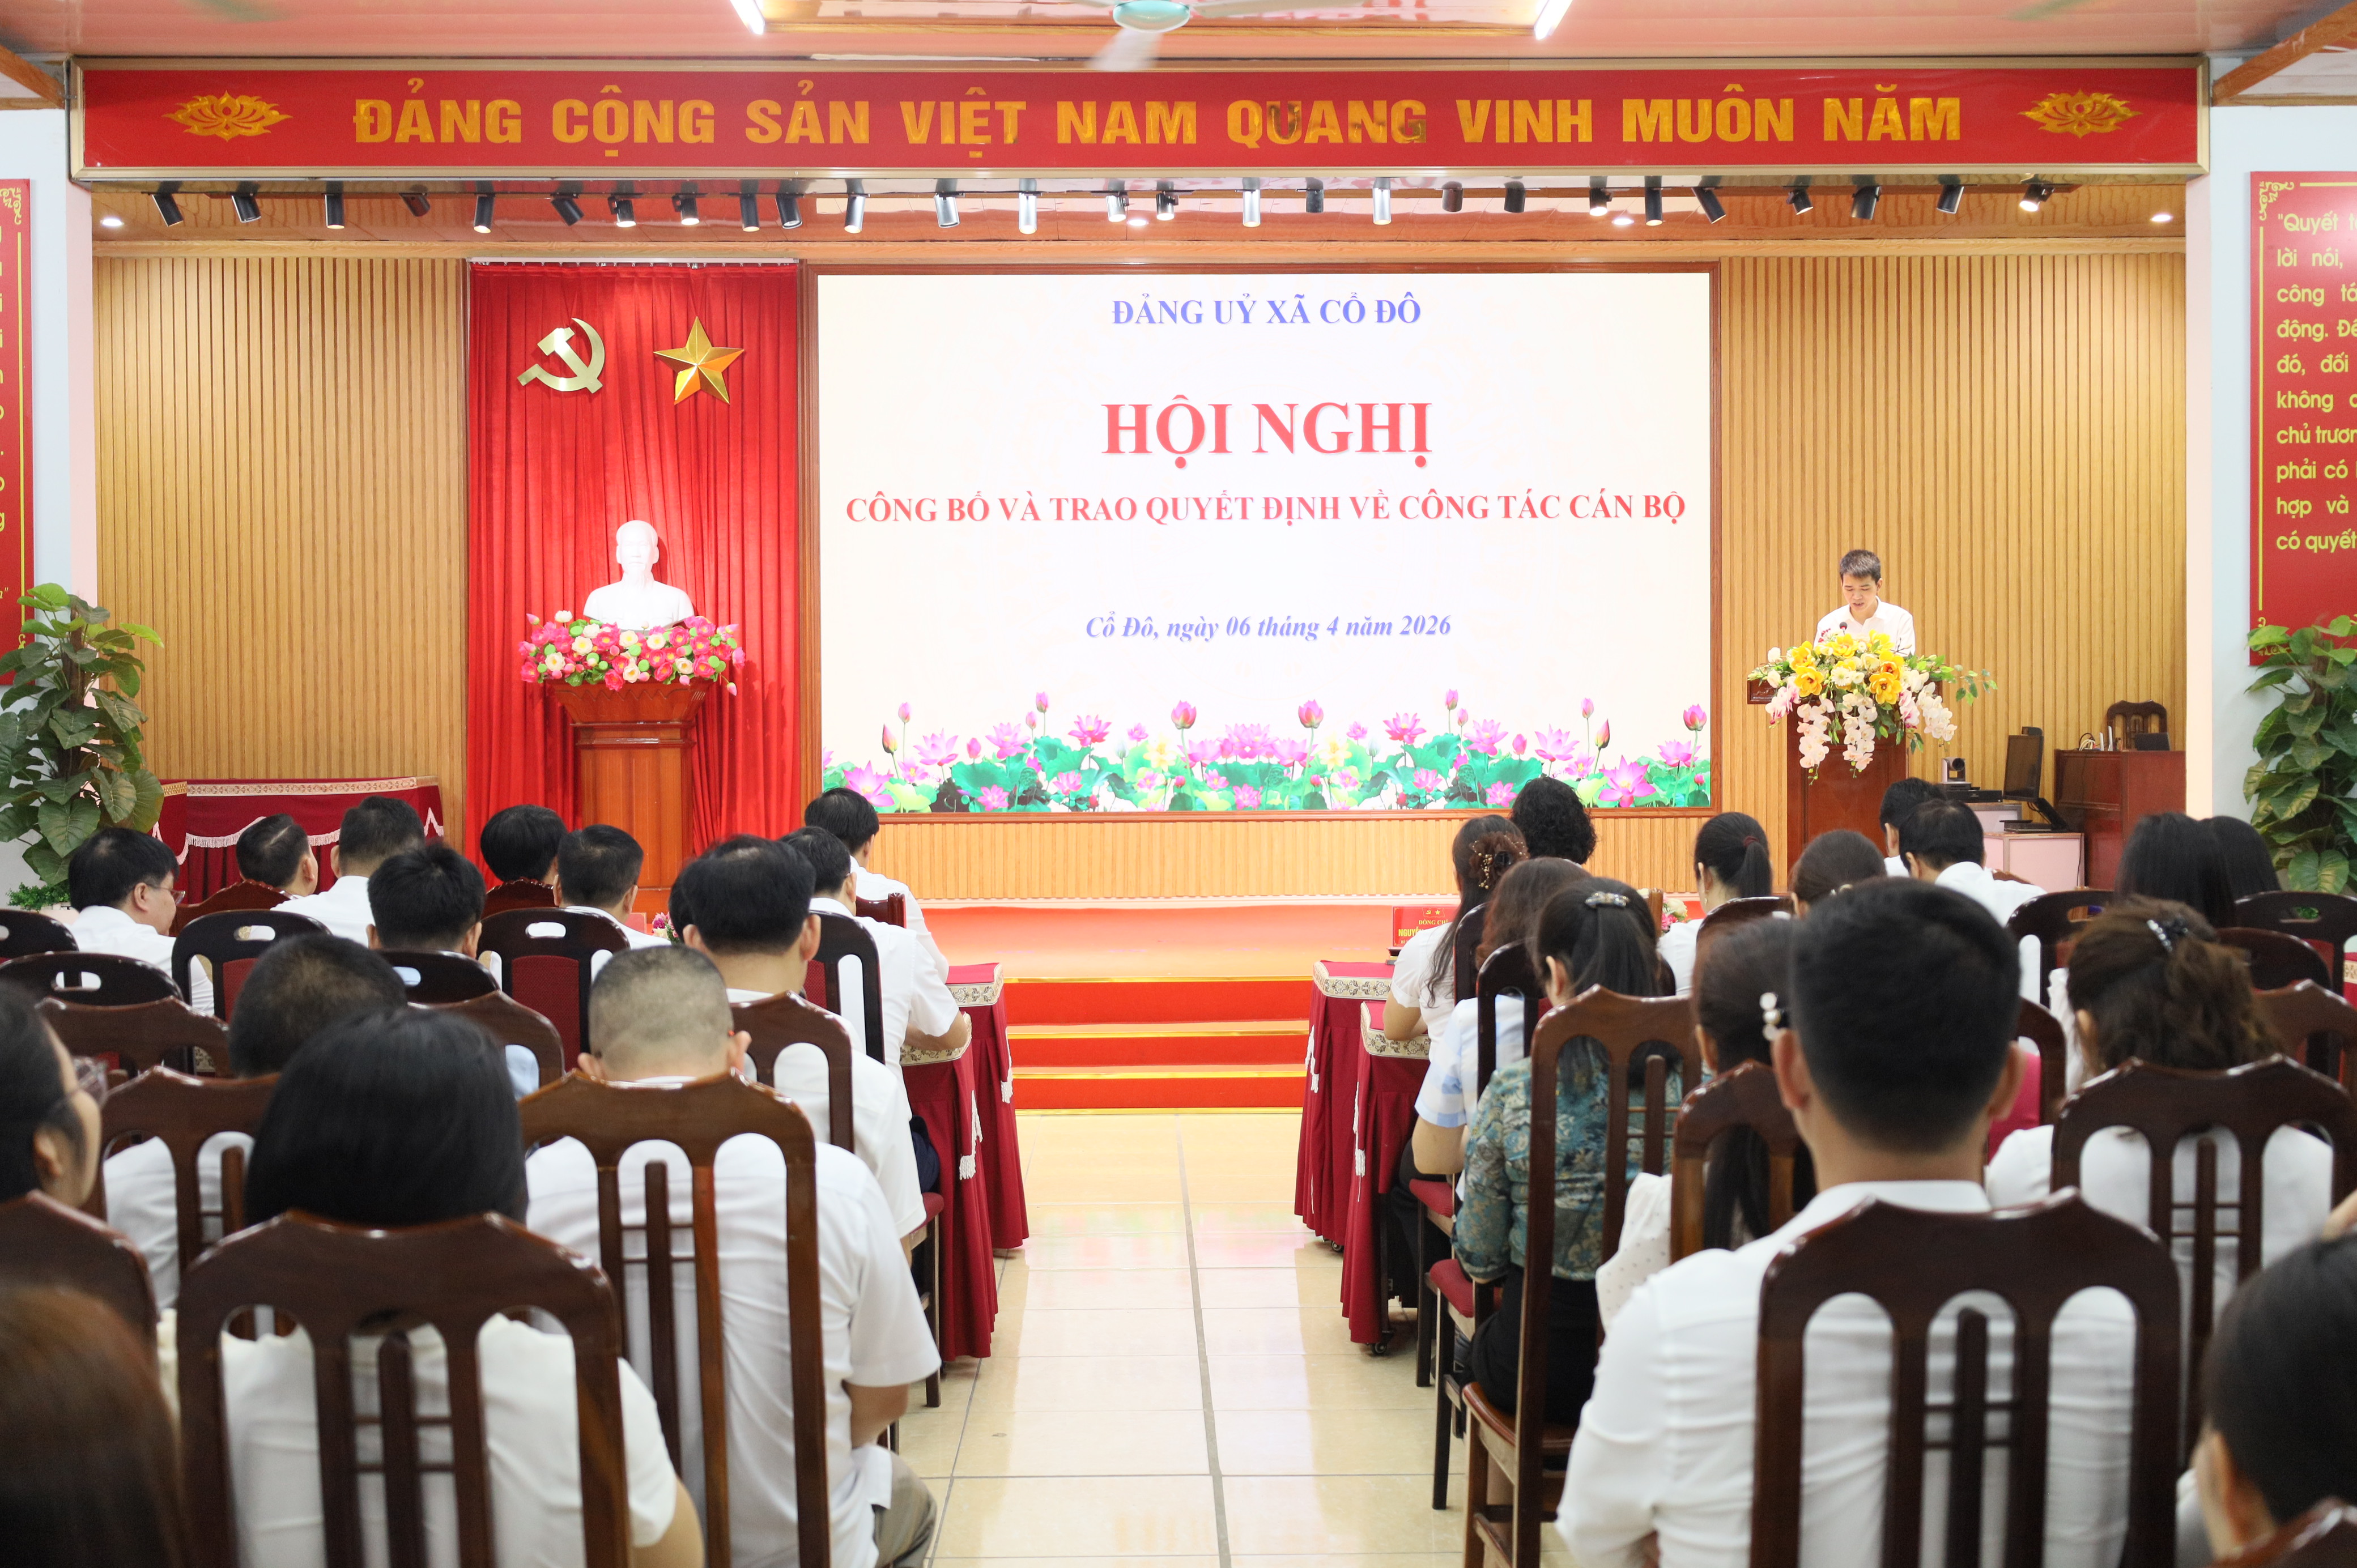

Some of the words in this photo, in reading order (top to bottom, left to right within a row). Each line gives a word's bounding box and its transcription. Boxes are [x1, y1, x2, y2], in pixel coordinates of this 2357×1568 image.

[353, 78, 522, 144] ĐẢNG
[552, 84, 715, 157] CỘNG
[745, 80, 870, 144] SẢN
[900, 87, 1027, 158] VIỆT
[1057, 100, 1196, 144] NAM
[1227, 99, 1427, 149] QUANG
[1456, 99, 1593, 143] VINH
[1622, 83, 1794, 143] MUÔN
[1823, 83, 1962, 141] NĂM
[2278, 210, 2339, 235] "Quyết
[2277, 247, 2298, 267] lời
[2312, 247, 2343, 269] nói,
[1112, 293, 1204, 325] ĐẢNG
[1214, 293, 1257, 325] UỶ
[1266, 293, 1311, 324] XÃ
[1320, 292, 1366, 324] CỔ
[1374, 291, 1422, 323] ĐÔ
[2277, 284, 2325, 307] công
[2277, 319, 2329, 343] động.
[2277, 353, 2306, 376] đó,
[2320, 351, 2349, 373] đối
[2277, 390, 2334, 413] không
[1101, 394, 1233, 469] HỘI
[1252, 402, 1433, 468] NGHỊ
[2277, 422, 2311, 444] chủ
[2277, 457, 2317, 484] phải
[2324, 458, 2349, 480] có
[846, 491, 937, 522] CÔNG
[947, 491, 990, 522] BỐ
[998, 491, 1042, 522] VÀ
[1049, 497, 1138, 521] TRAO
[1146, 489, 1254, 526] QUYẾT
[1262, 496, 1341, 527] ĐỊNH
[1350, 488, 1390, 520] VỀ
[1399, 488, 1489, 520] CÔNG
[1497, 488, 1560, 519] TÁC
[1569, 488, 1632, 519] CÁN
[1643, 491, 1686, 525] BỘ
[2277, 496, 2313, 519] hợp
[2326, 494, 2349, 515] và
[2277, 530, 2300, 549] có
[2305, 528, 2357, 553] quyết
[1085, 611, 1116, 638] Cổ
[1122, 616, 1160, 640] Đô,
[1166, 615, 1219, 641] ngày
[1226, 616, 1251, 636] 06
[1257, 615, 1320, 641] tháng
[1326, 616, 1339, 635] 4
[1345, 615, 1393, 635] năm
[1399, 614, 1452, 635] 2026
[1398, 926, 1424, 937] NGUYỄ
